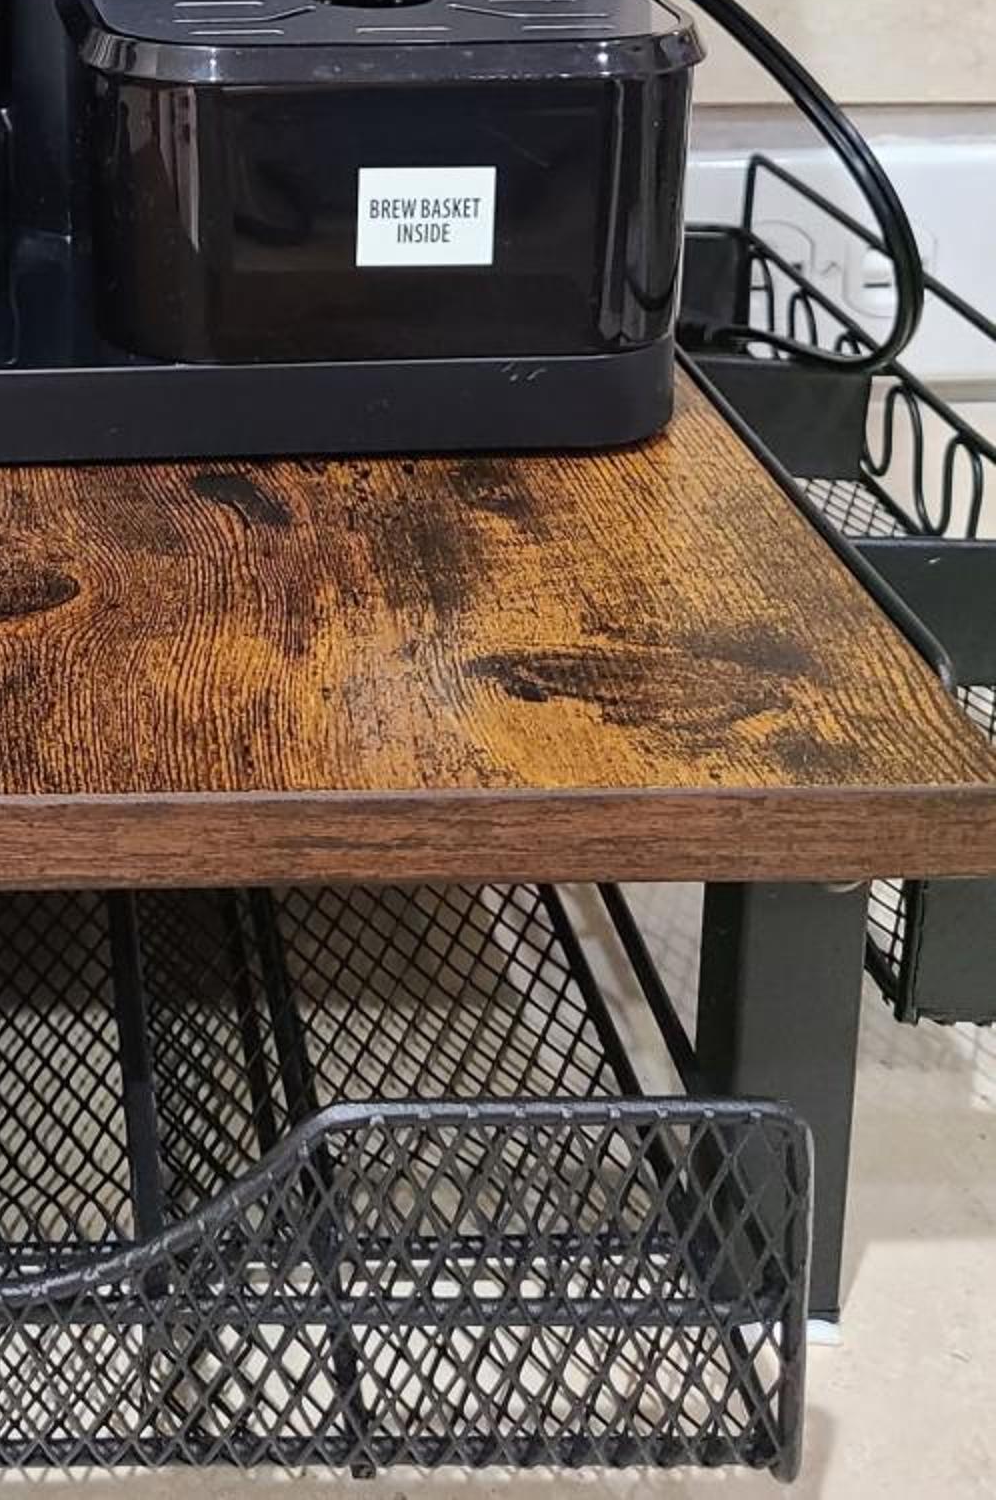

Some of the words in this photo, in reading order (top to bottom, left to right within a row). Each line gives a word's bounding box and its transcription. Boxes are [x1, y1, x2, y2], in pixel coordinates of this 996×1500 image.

[369, 199, 417, 219] BREW
[421, 198, 481, 218] BASKET
[397, 223, 451, 243] INSIDE
